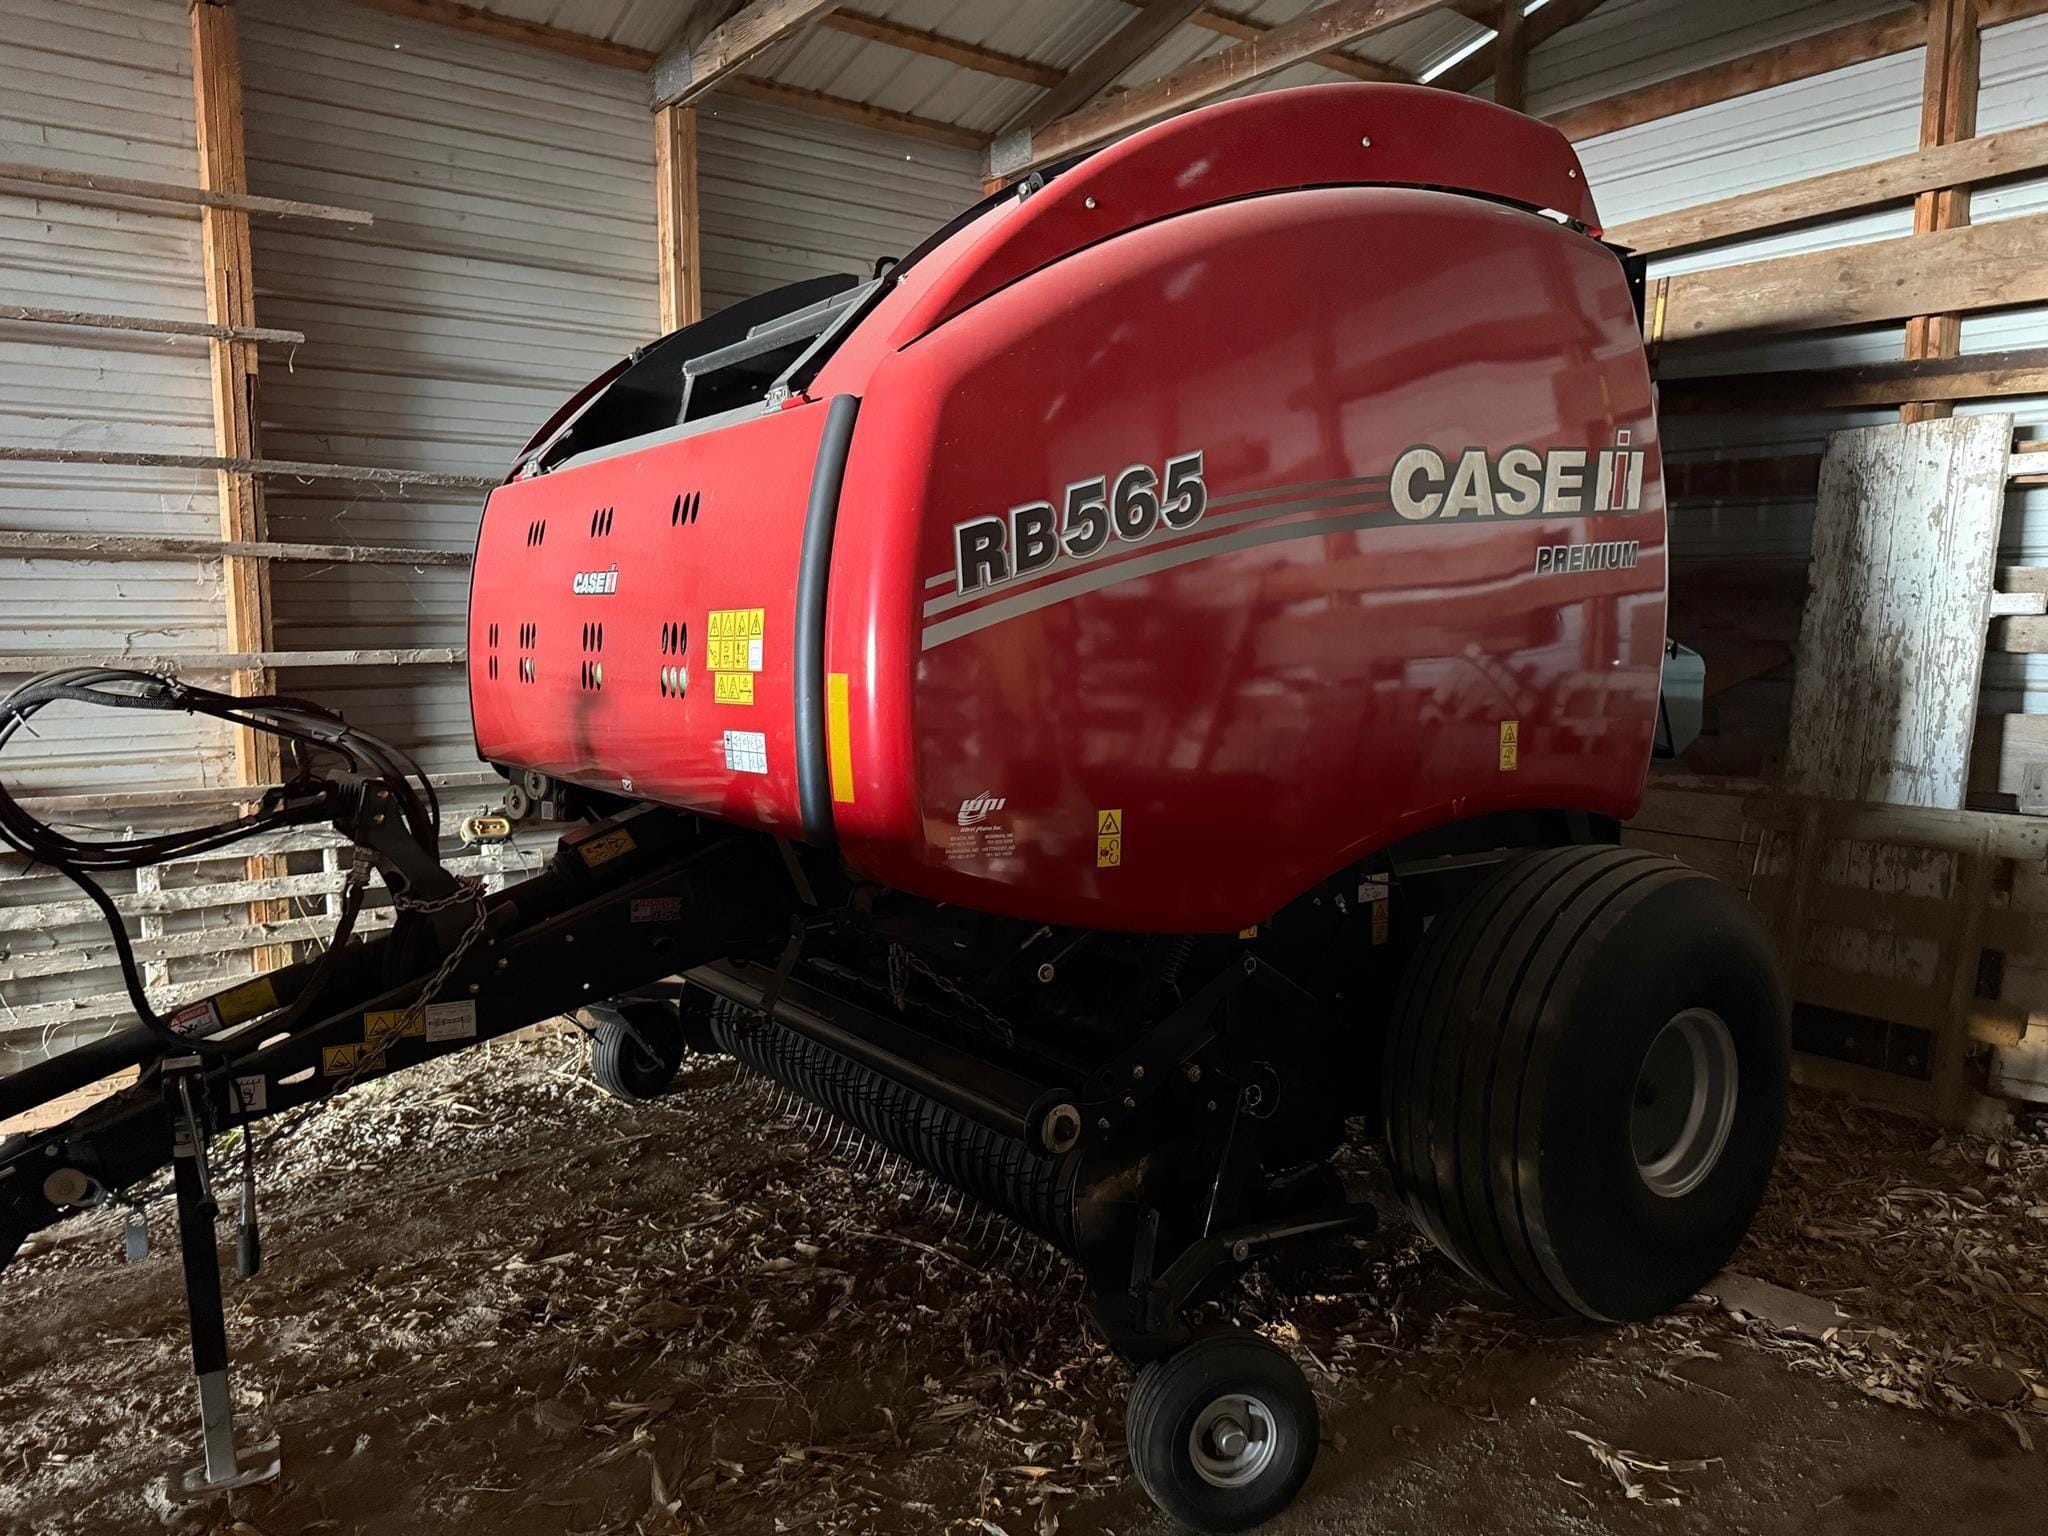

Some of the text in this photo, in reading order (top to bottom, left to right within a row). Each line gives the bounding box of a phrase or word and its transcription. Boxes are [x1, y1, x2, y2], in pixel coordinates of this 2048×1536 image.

[1390, 448, 1587, 520] CASE
[954, 450, 1208, 597] RB565
[573, 572, 606, 593] CASE
[1535, 541, 1639, 575] PREMIUM
